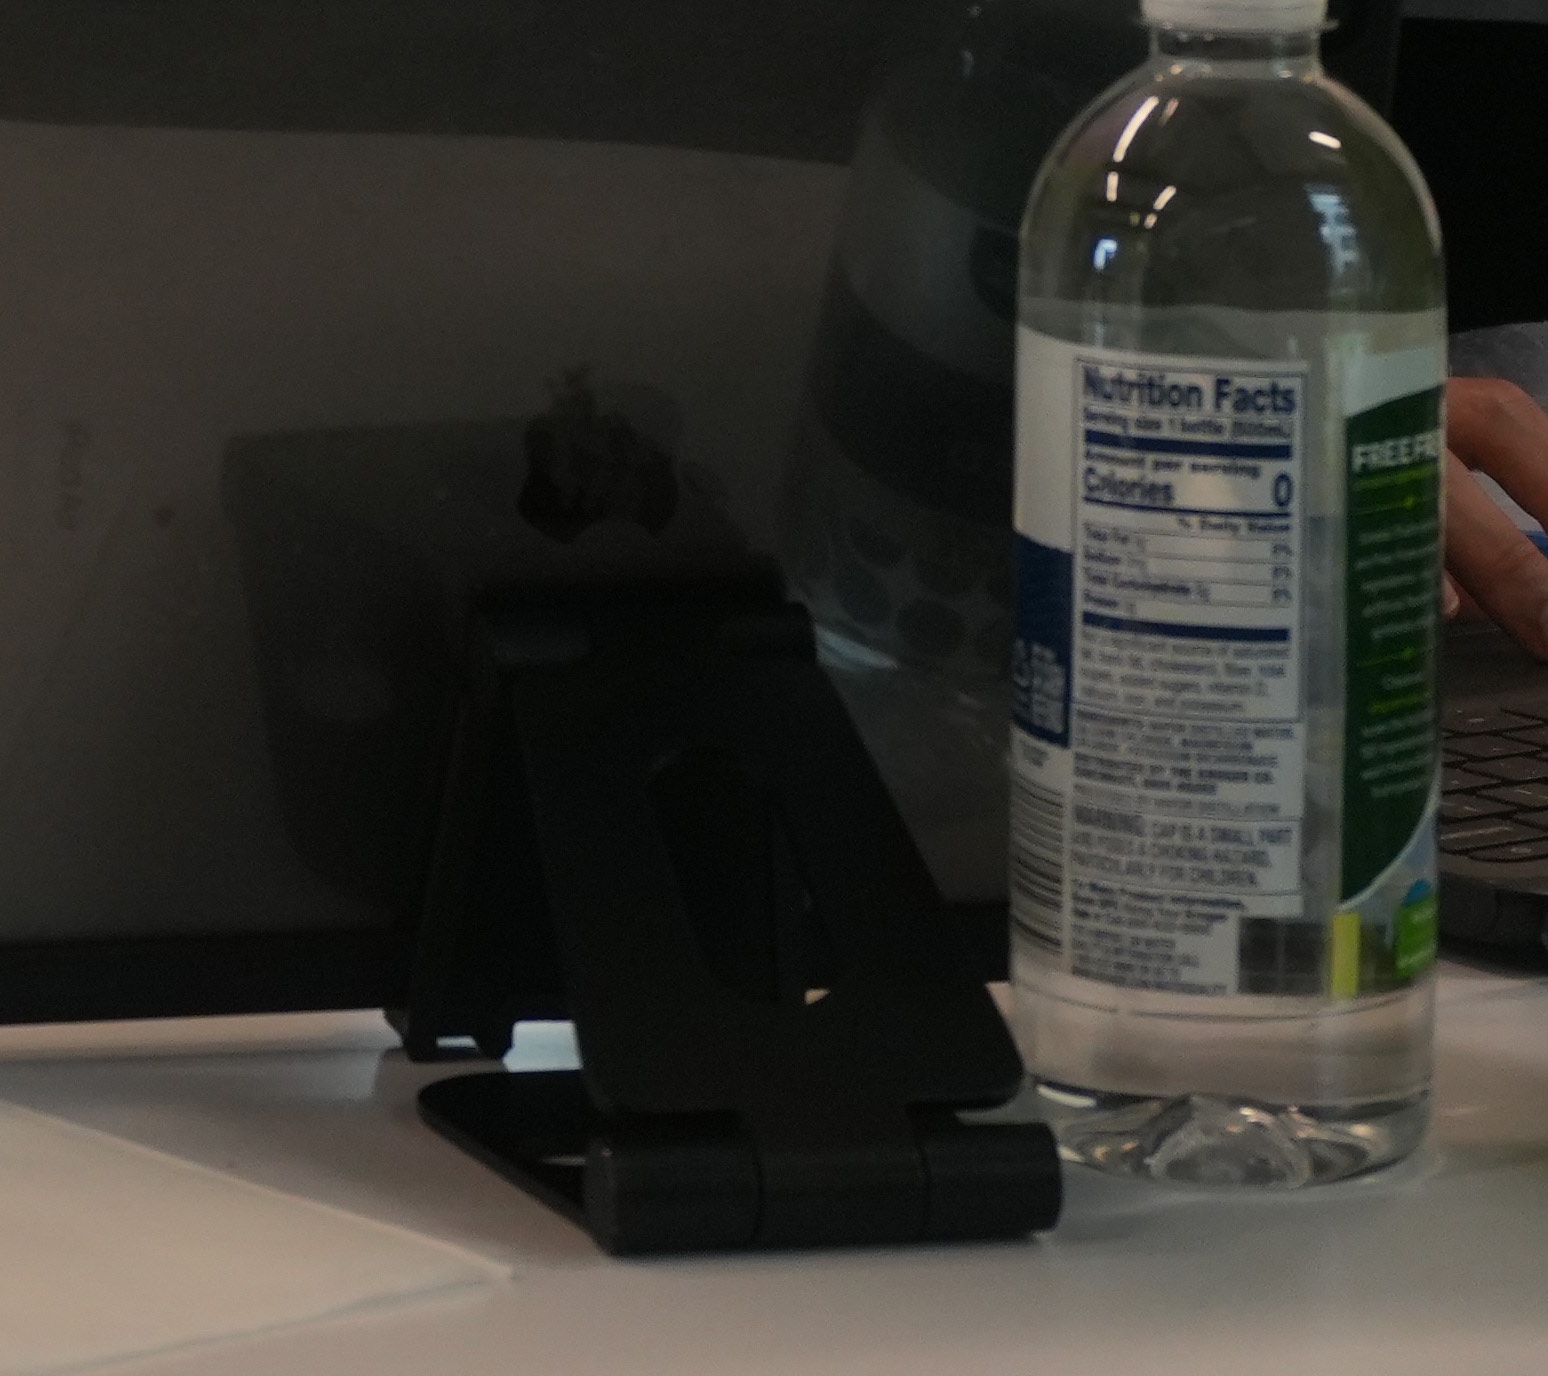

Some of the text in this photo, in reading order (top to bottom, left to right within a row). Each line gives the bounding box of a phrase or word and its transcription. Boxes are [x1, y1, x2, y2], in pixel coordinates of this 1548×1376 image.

[1084, 365, 1296, 414] Nutrition Facts
[1085, 467, 1293, 508] Calories 0
